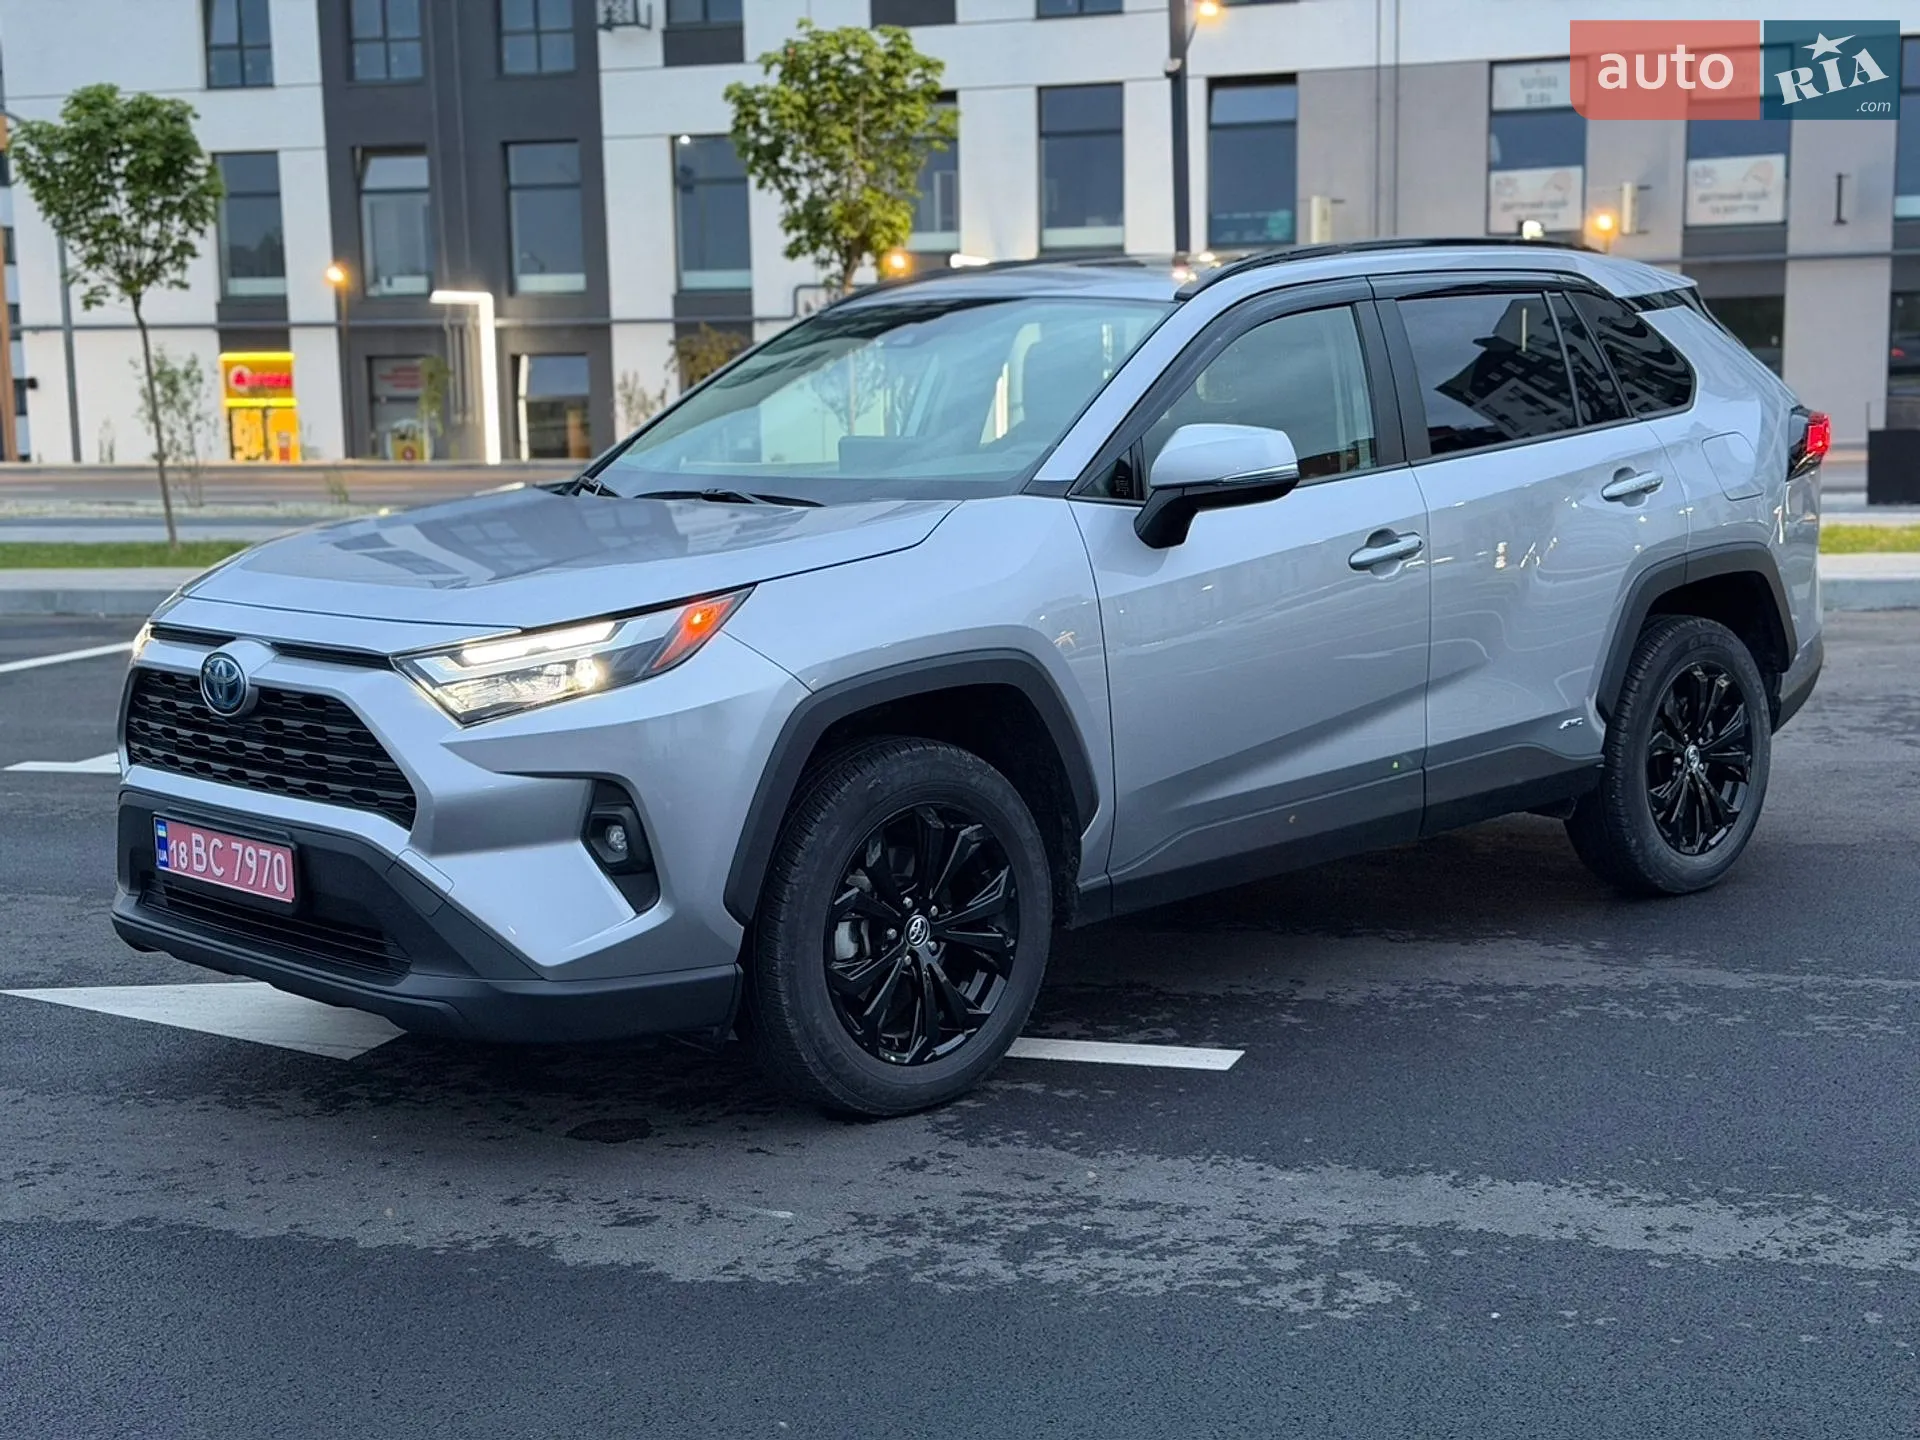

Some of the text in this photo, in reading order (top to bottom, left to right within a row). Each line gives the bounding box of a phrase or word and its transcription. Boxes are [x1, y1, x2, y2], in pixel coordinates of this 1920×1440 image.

[158, 849, 169, 862] UA
[169, 832, 287, 893] 18 BC 7970
